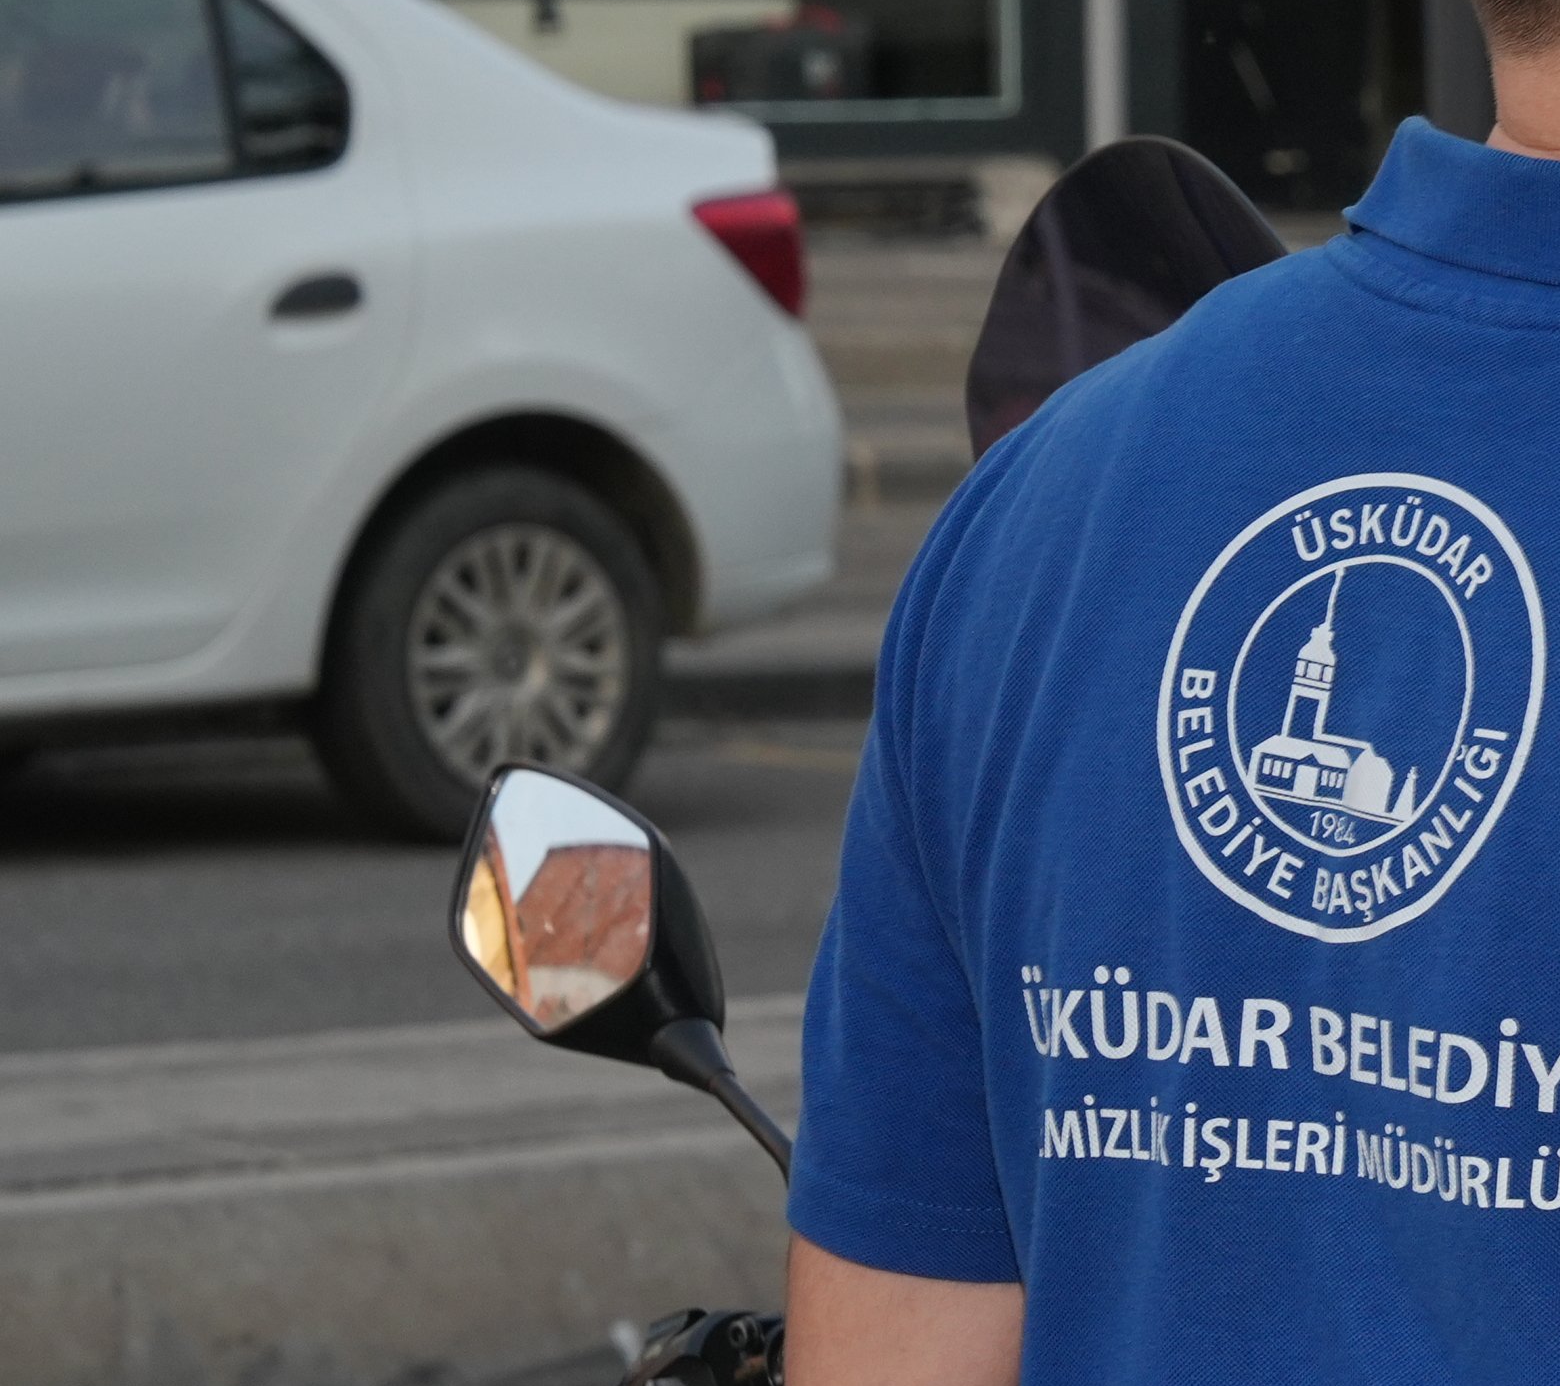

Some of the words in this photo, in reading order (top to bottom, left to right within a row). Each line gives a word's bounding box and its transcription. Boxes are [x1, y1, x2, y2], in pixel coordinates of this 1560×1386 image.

[1291, 495, 1494, 601] ÜSKÜDAR
[1176, 667, 1305, 900] BELEDİYE
[1312, 727, 1511, 923] BAŞKANLIĞI
[1038, 1093, 1173, 1167] MİZLİK
[1181, 1100, 1348, 1184] İŞLERİ
